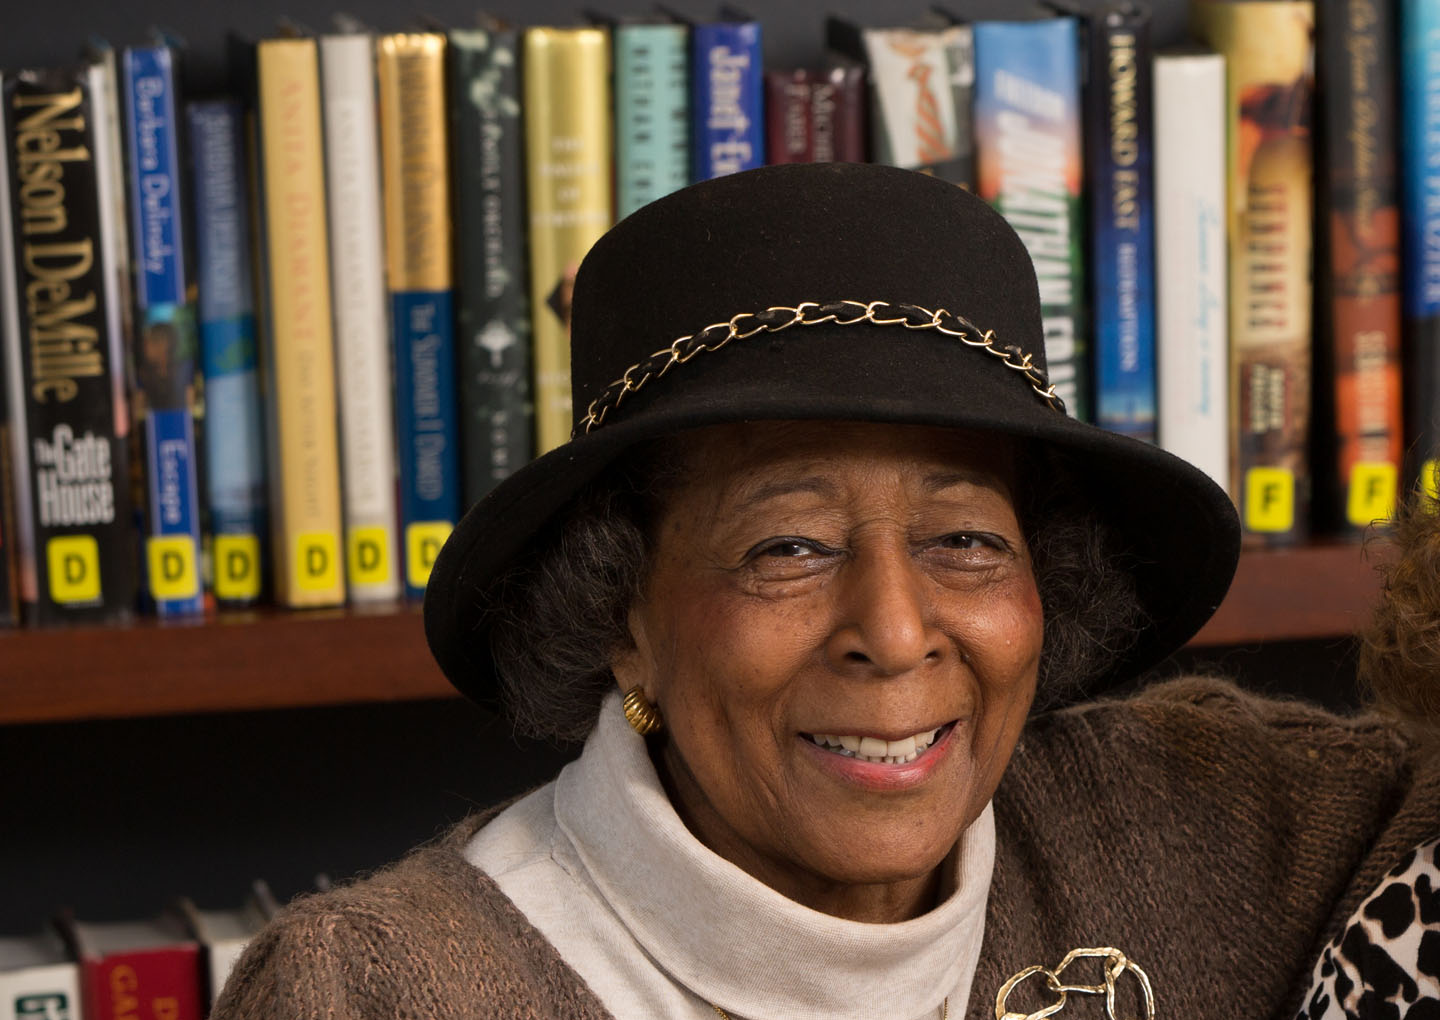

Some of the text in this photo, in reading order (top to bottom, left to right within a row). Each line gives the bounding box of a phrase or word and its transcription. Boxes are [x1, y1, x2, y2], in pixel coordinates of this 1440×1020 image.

[709, 46, 752, 178] Janet Ev
[812, 83, 836, 163] MICHE
[1107, 35, 1141, 235] HOWARD FAST
[136, 76, 176, 276] Barbara Delinsky
[14, 87, 104, 404] Nelson DeMille
[158, 438, 188, 525] Escape
[1365, 477, 1383, 507] F
[1262, 483, 1280, 514] F
[64, 553, 87, 584] D
[163, 551, 185, 582] D
[227, 550, 250, 582] D
[306, 545, 328, 577] D
[358, 540, 381, 572] D
[421, 537, 443, 568] D
